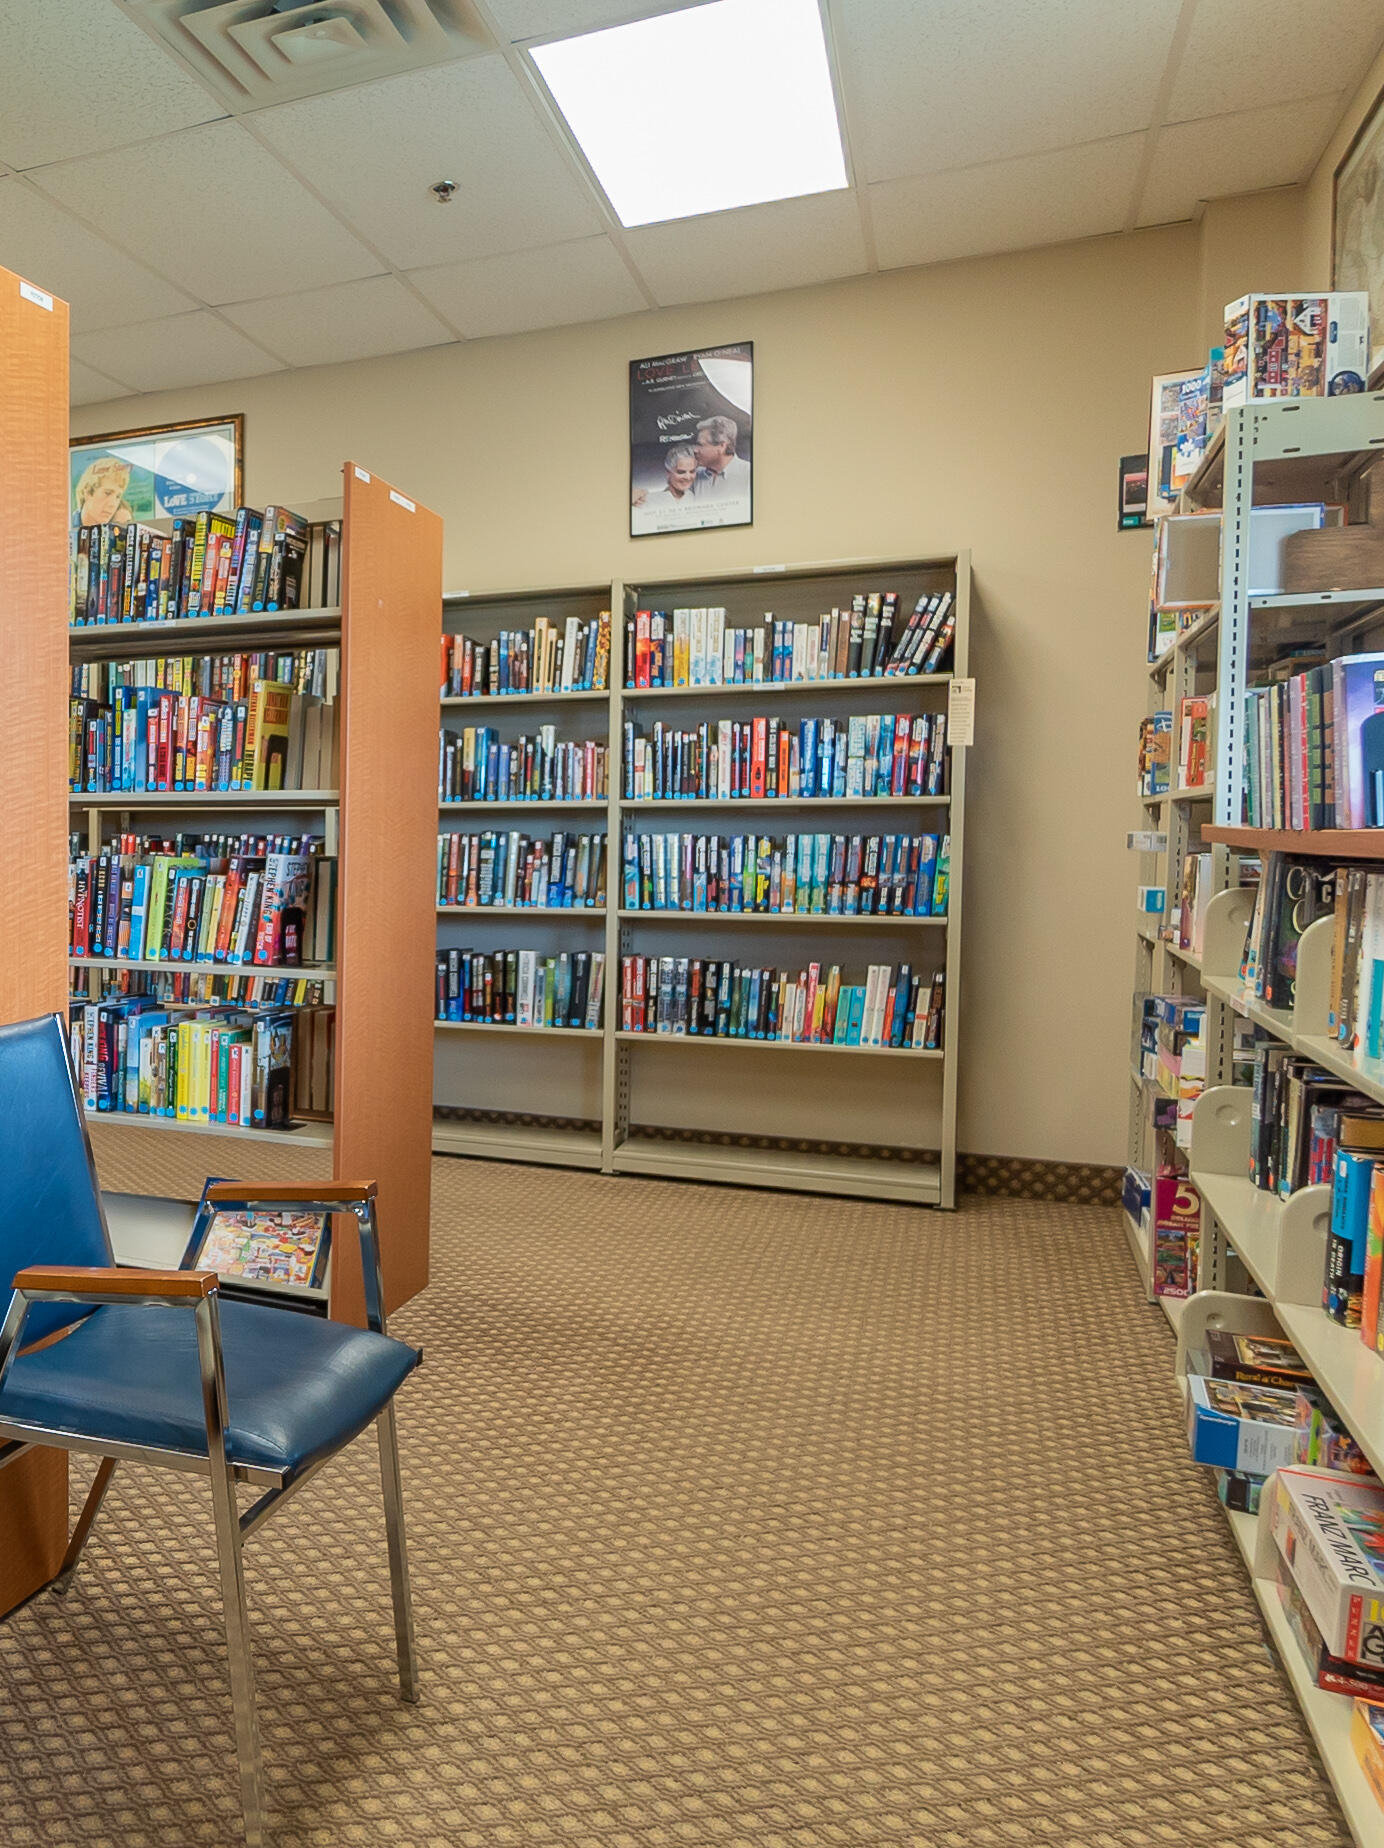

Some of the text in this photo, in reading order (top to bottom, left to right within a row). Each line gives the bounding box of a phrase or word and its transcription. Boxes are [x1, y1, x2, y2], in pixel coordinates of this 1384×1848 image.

[77, 881, 87, 929] HYPNOTIST
[264, 895, 274, 914] KING
[96, 1063, 109, 1095] REVIVAL
[1173, 1184, 1199, 1215] 5
[1336, 1246, 1344, 1276] ORIGIN
[1302, 1493, 1376, 1588] FRANZ MARC
